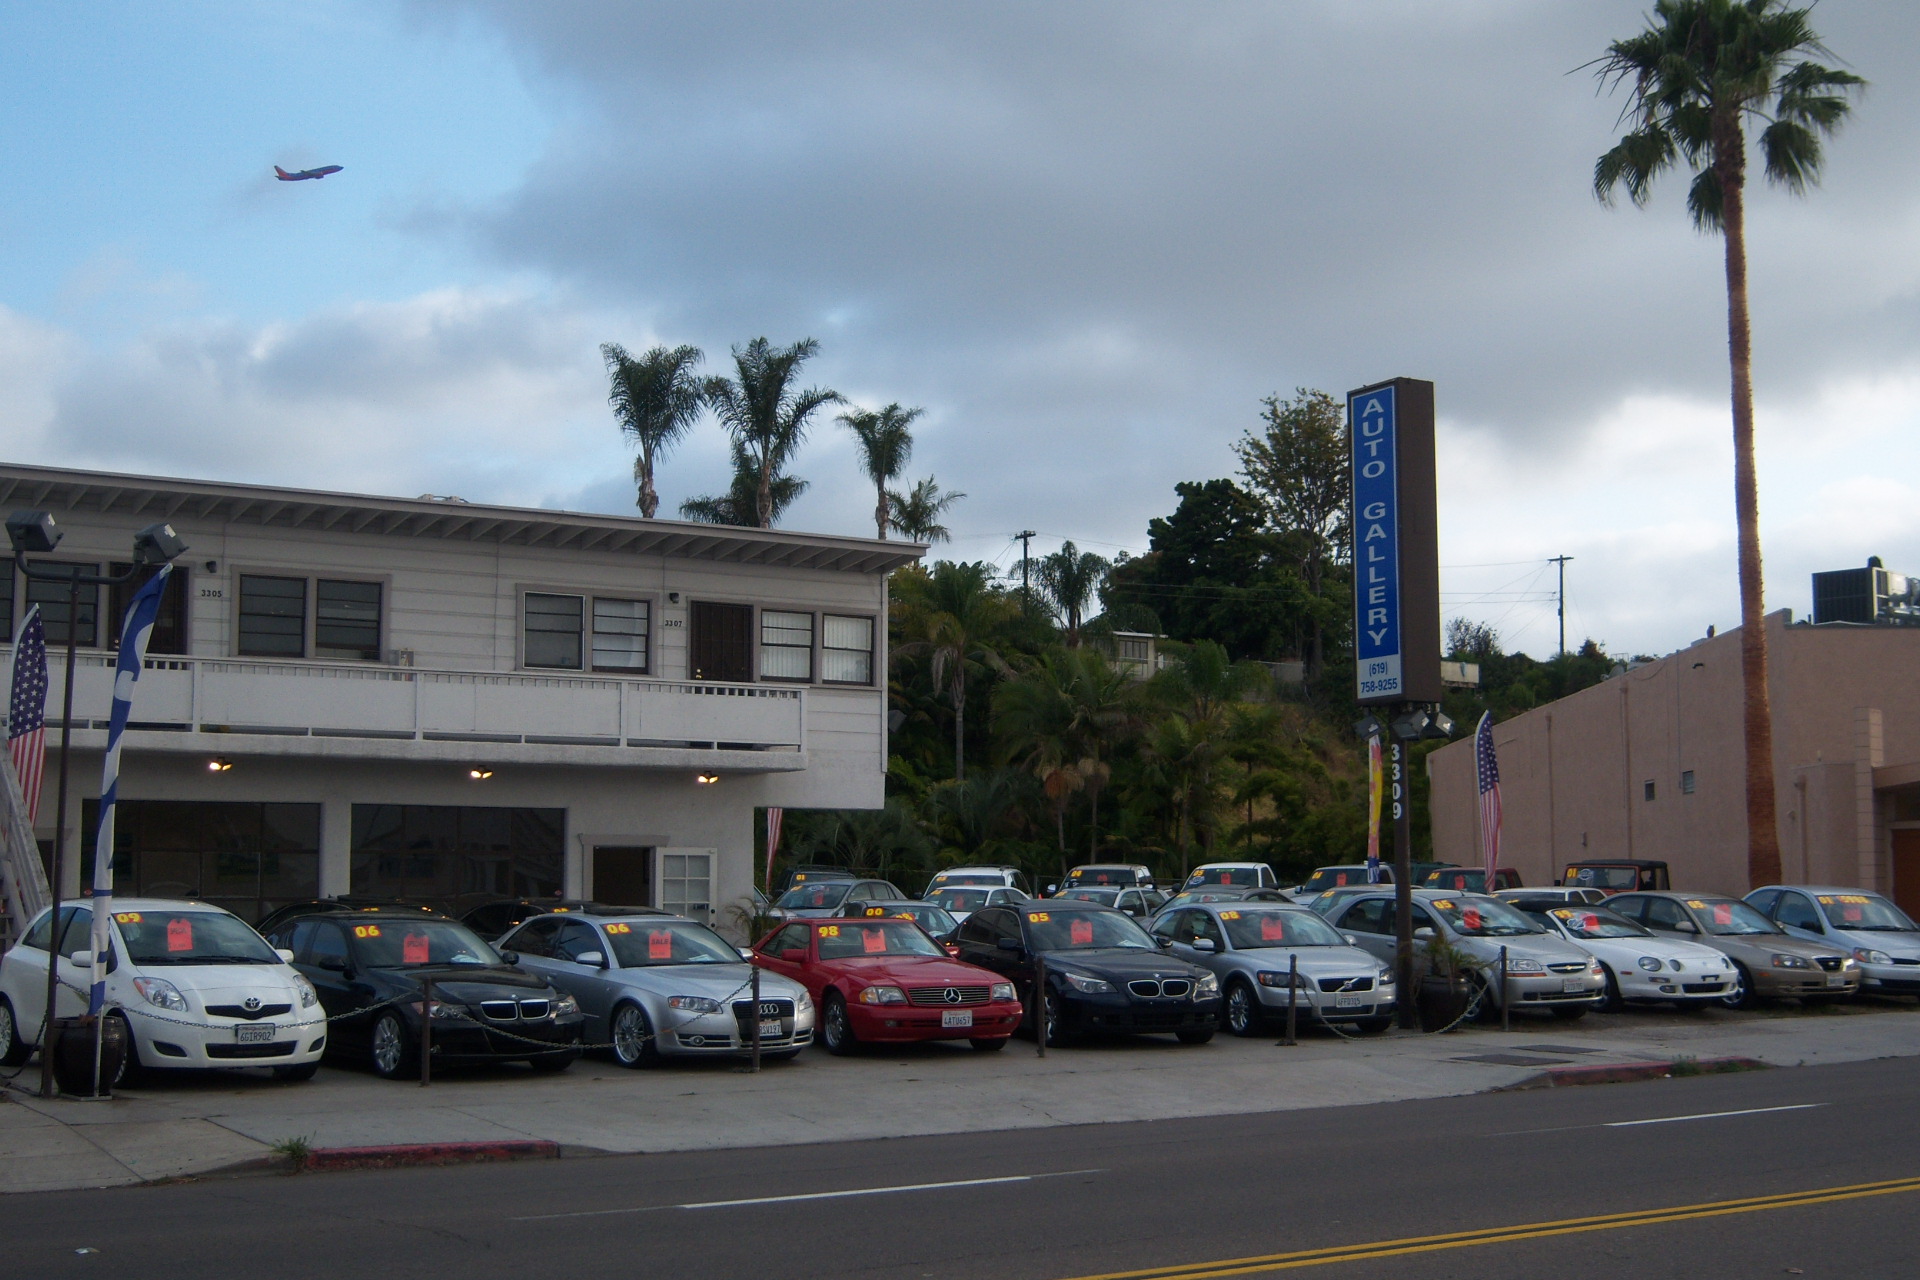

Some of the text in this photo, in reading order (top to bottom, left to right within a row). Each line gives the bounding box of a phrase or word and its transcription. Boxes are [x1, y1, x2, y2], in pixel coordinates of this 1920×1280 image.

[1362, 398, 1387, 646] AUTO GALLERY
[201, 589, 222, 598] 3305
[1369, 661, 1387, 677] (619)
[1360, 677, 1398, 693] 758-9255
[1391, 743, 1402, 819] 3309
[1433, 900, 1453, 909] 05
[1687, 900, 1705, 909] 05
[116, 913, 140, 923] 09
[1028, 912, 1049, 923] 05
[1219, 911, 1239, 920] 08
[355, 925, 380, 937] 06
[606, 923, 629, 934] 06
[818, 926, 838, 937] 98
